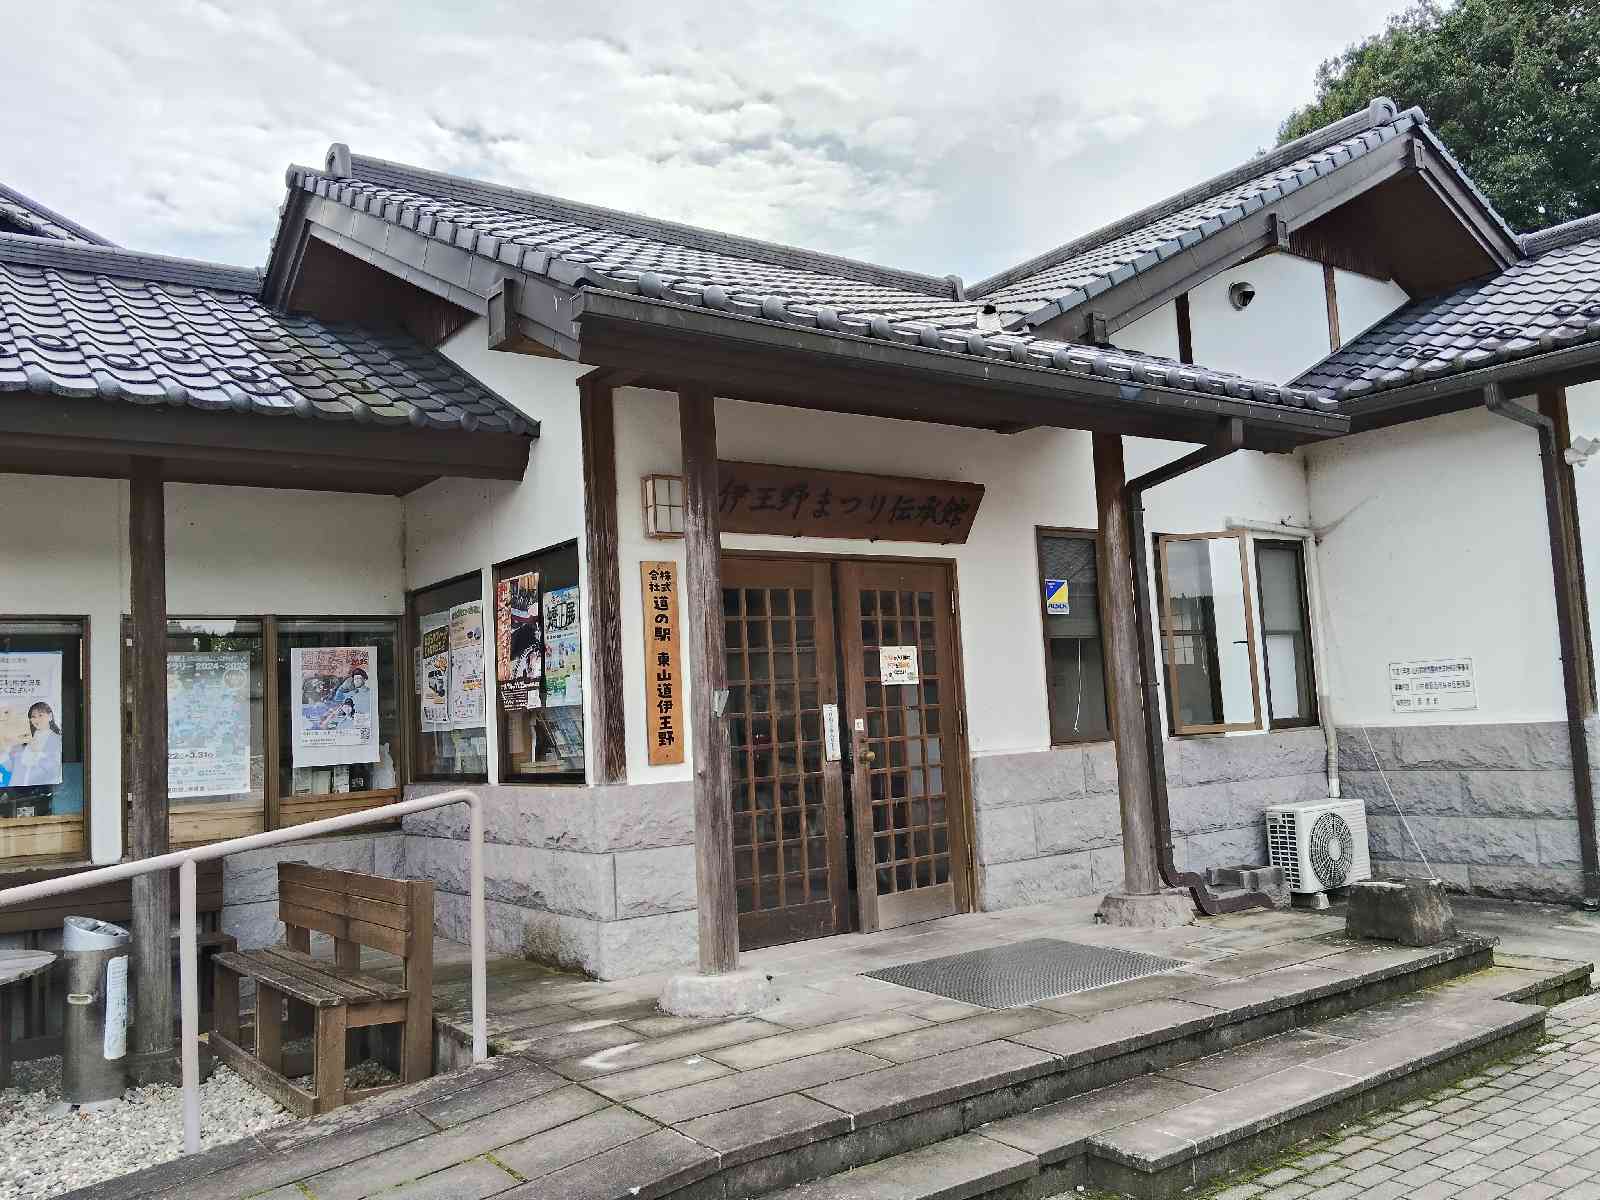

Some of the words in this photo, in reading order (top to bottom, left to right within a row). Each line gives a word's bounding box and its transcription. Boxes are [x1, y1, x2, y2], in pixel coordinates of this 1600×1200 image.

[718, 479, 969, 528] 伊王野まつり伝承館
[653, 596, 672, 641] 道の駅
[656, 652, 675, 747] 東山道伊王野
